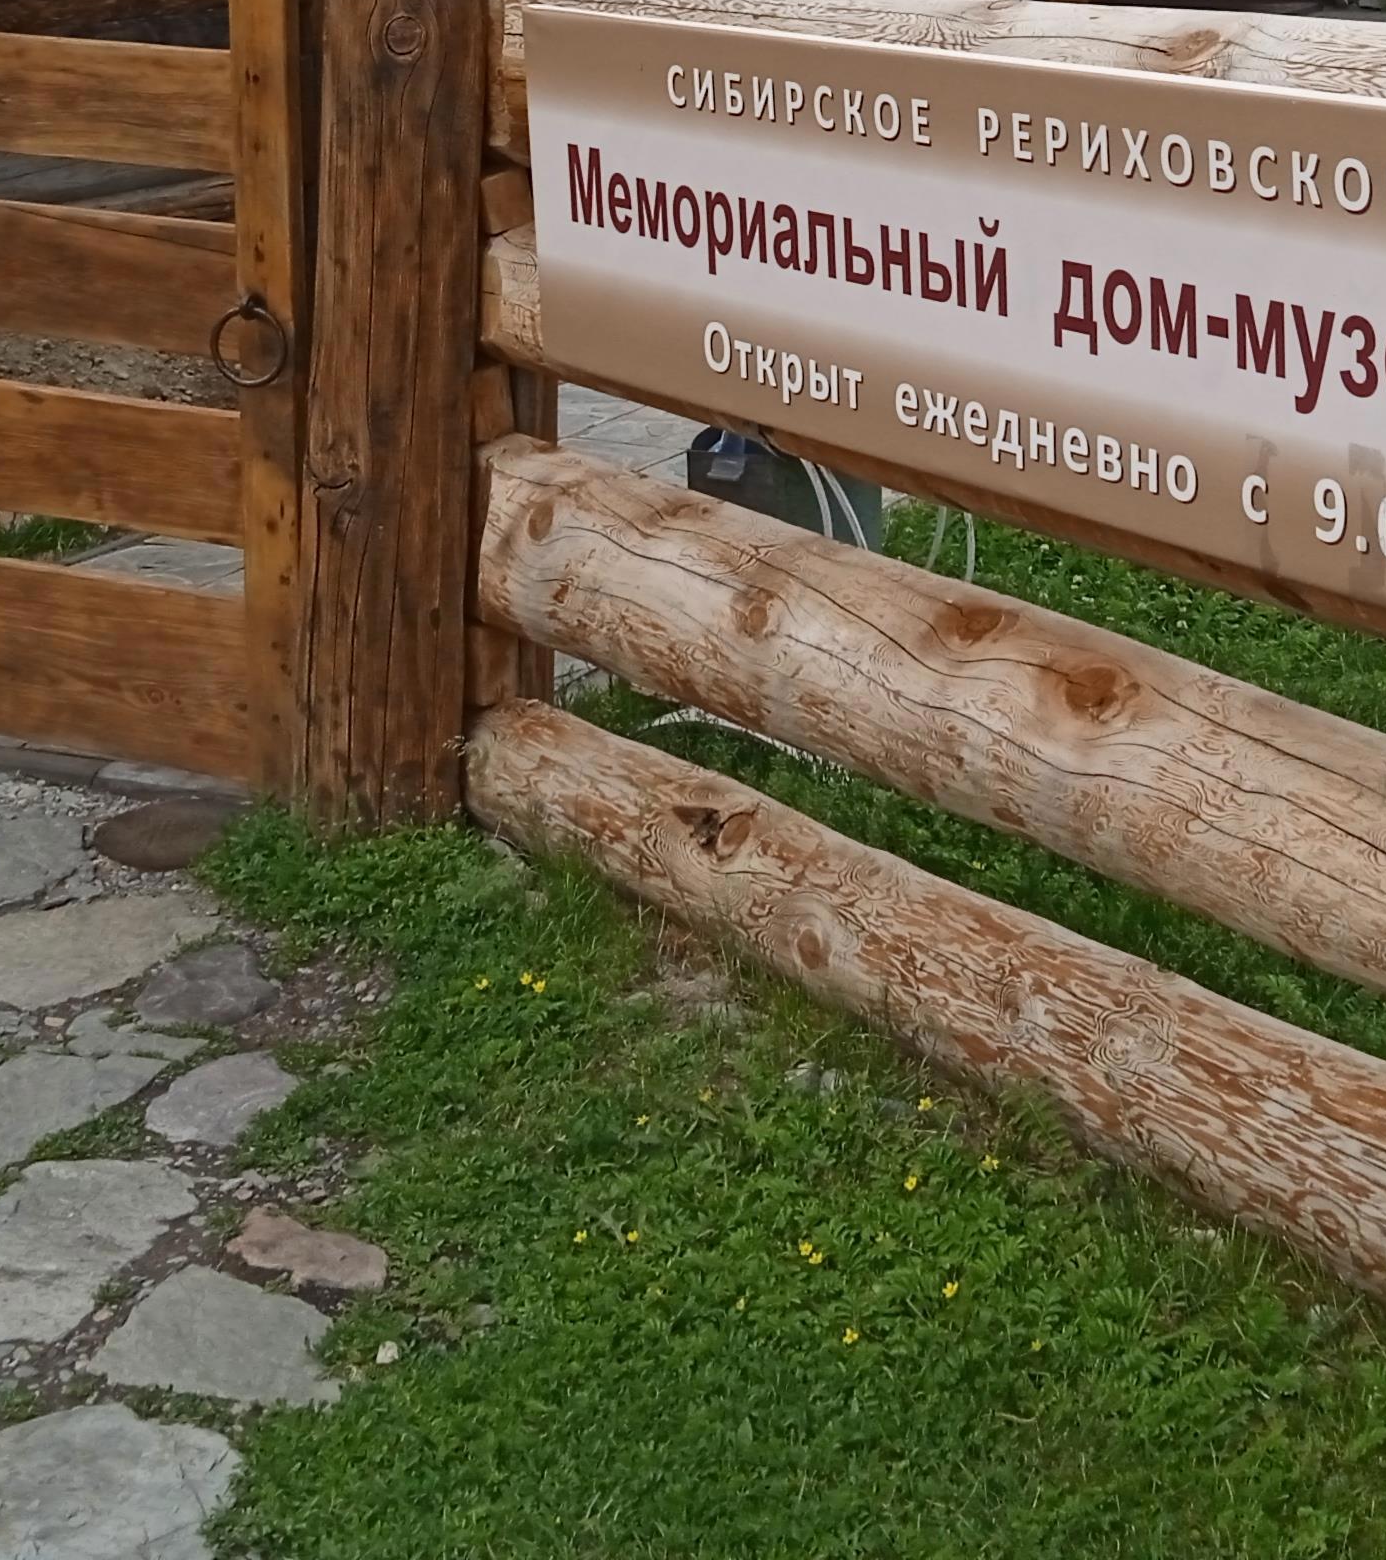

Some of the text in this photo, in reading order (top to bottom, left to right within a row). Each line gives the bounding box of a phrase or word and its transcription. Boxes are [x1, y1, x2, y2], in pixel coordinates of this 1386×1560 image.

[667, 64, 933, 147] СИБИРСКОЕ
[568, 142, 1009, 317] Мемориальный
[704, 320, 864, 411] Открыт
[895, 381, 1199, 504] ежедневно
[1241, 474, 1269, 525] с
